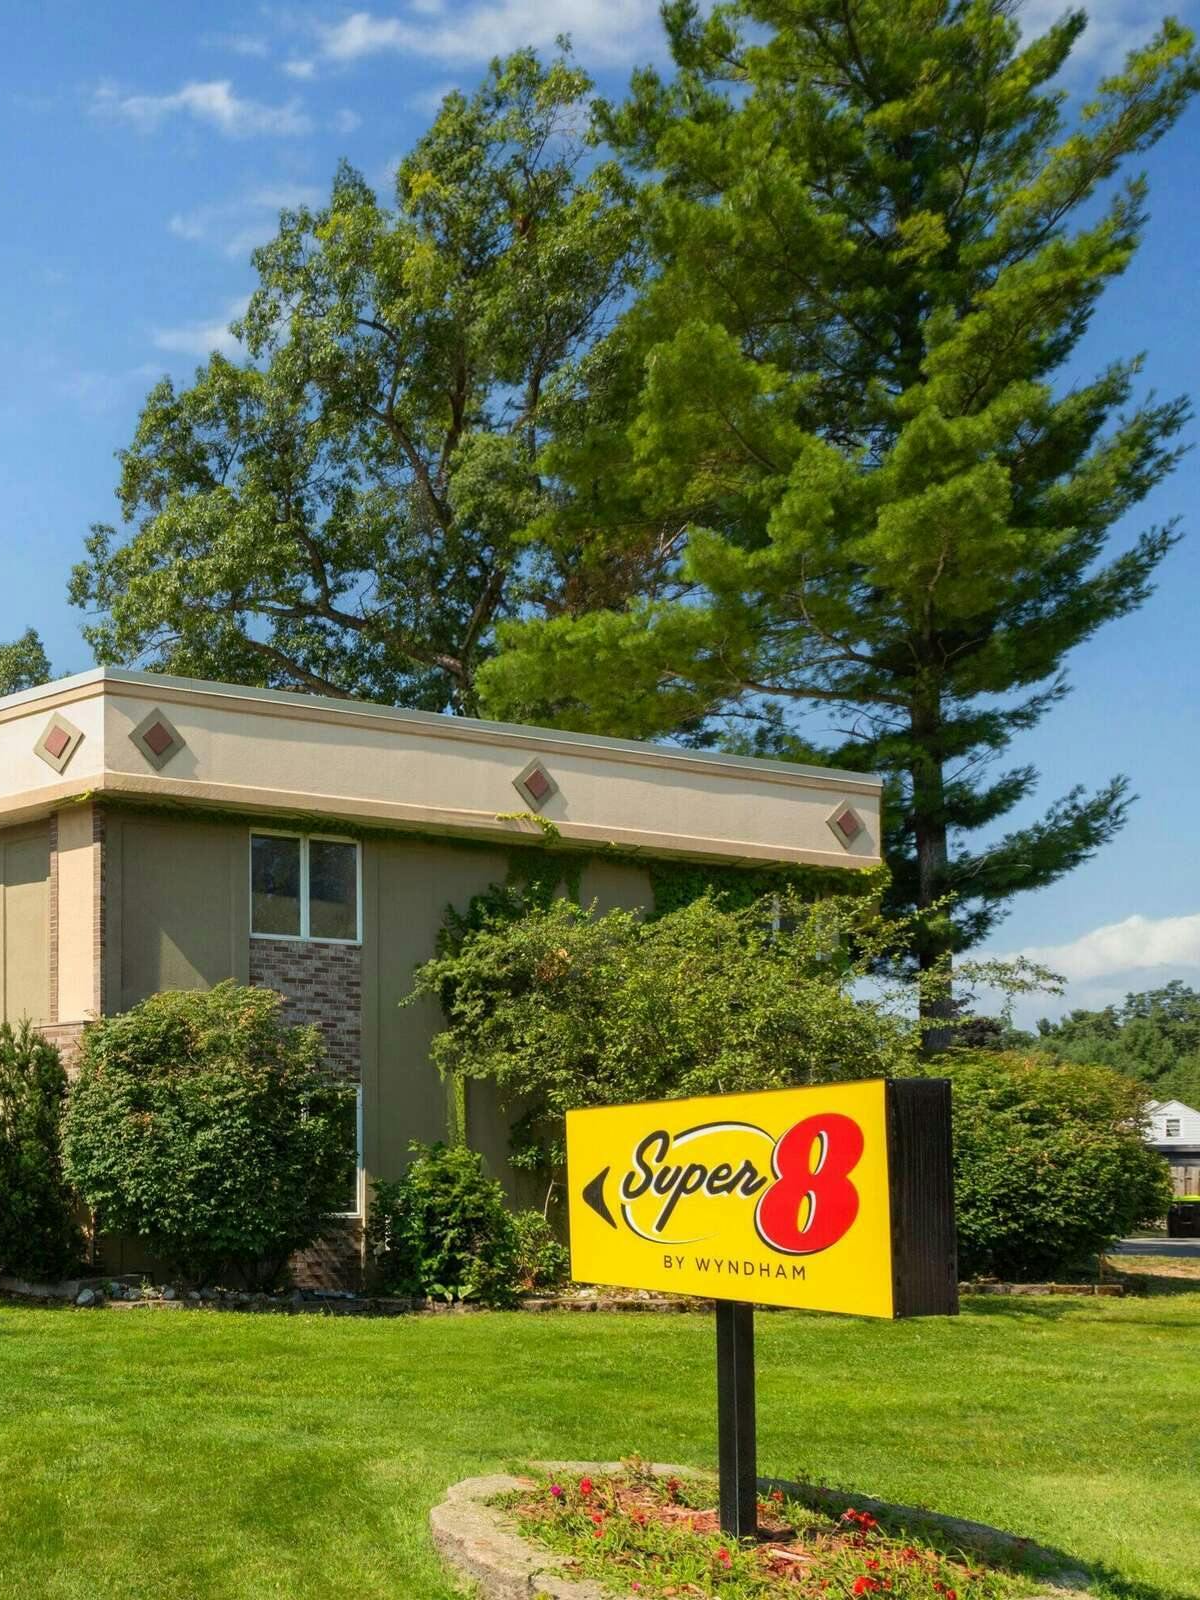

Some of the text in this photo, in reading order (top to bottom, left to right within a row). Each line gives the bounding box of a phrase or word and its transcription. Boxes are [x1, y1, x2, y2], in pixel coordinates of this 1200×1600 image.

[621, 1112, 865, 1257] Super 8
[663, 1255, 806, 1281] BY WYNDHAM
